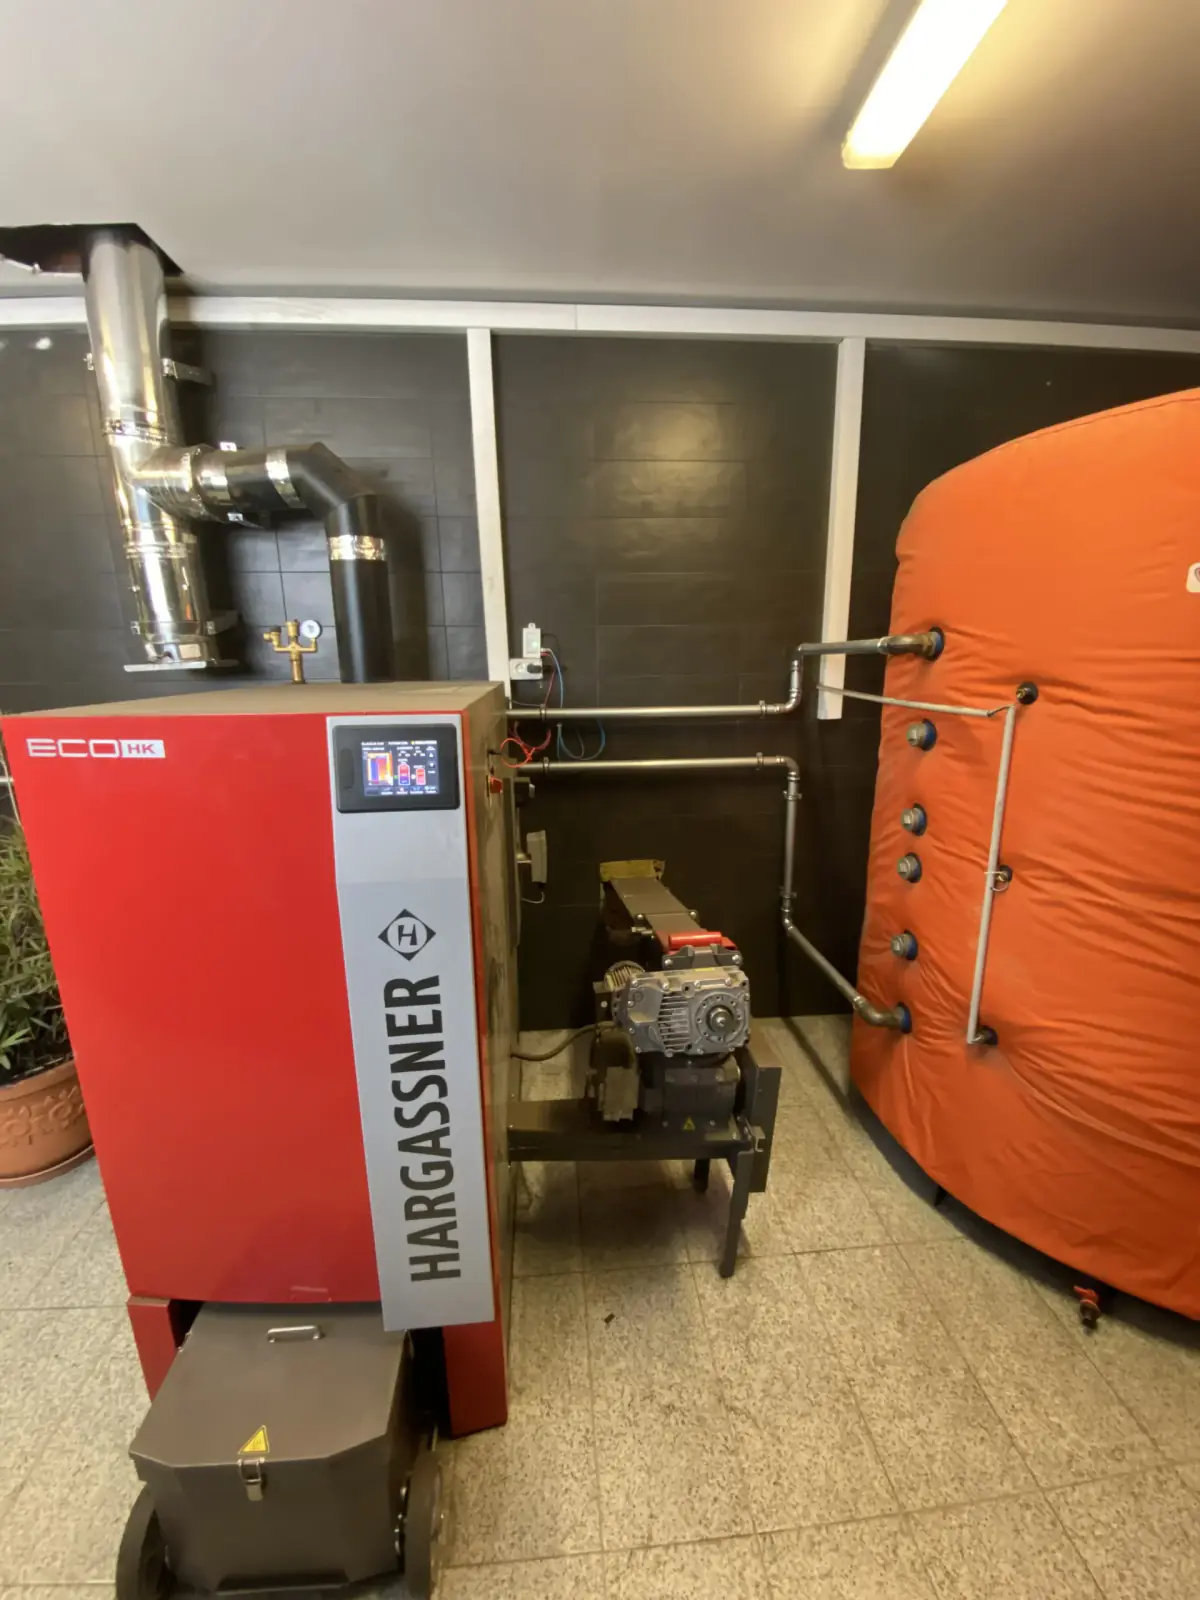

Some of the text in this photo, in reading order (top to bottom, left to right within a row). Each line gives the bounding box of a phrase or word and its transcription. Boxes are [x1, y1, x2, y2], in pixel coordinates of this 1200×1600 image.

[26, 738, 158, 758] ECO HK
[397, 923, 418, 946] H
[383, 974, 461, 1282] HARGASSNER
